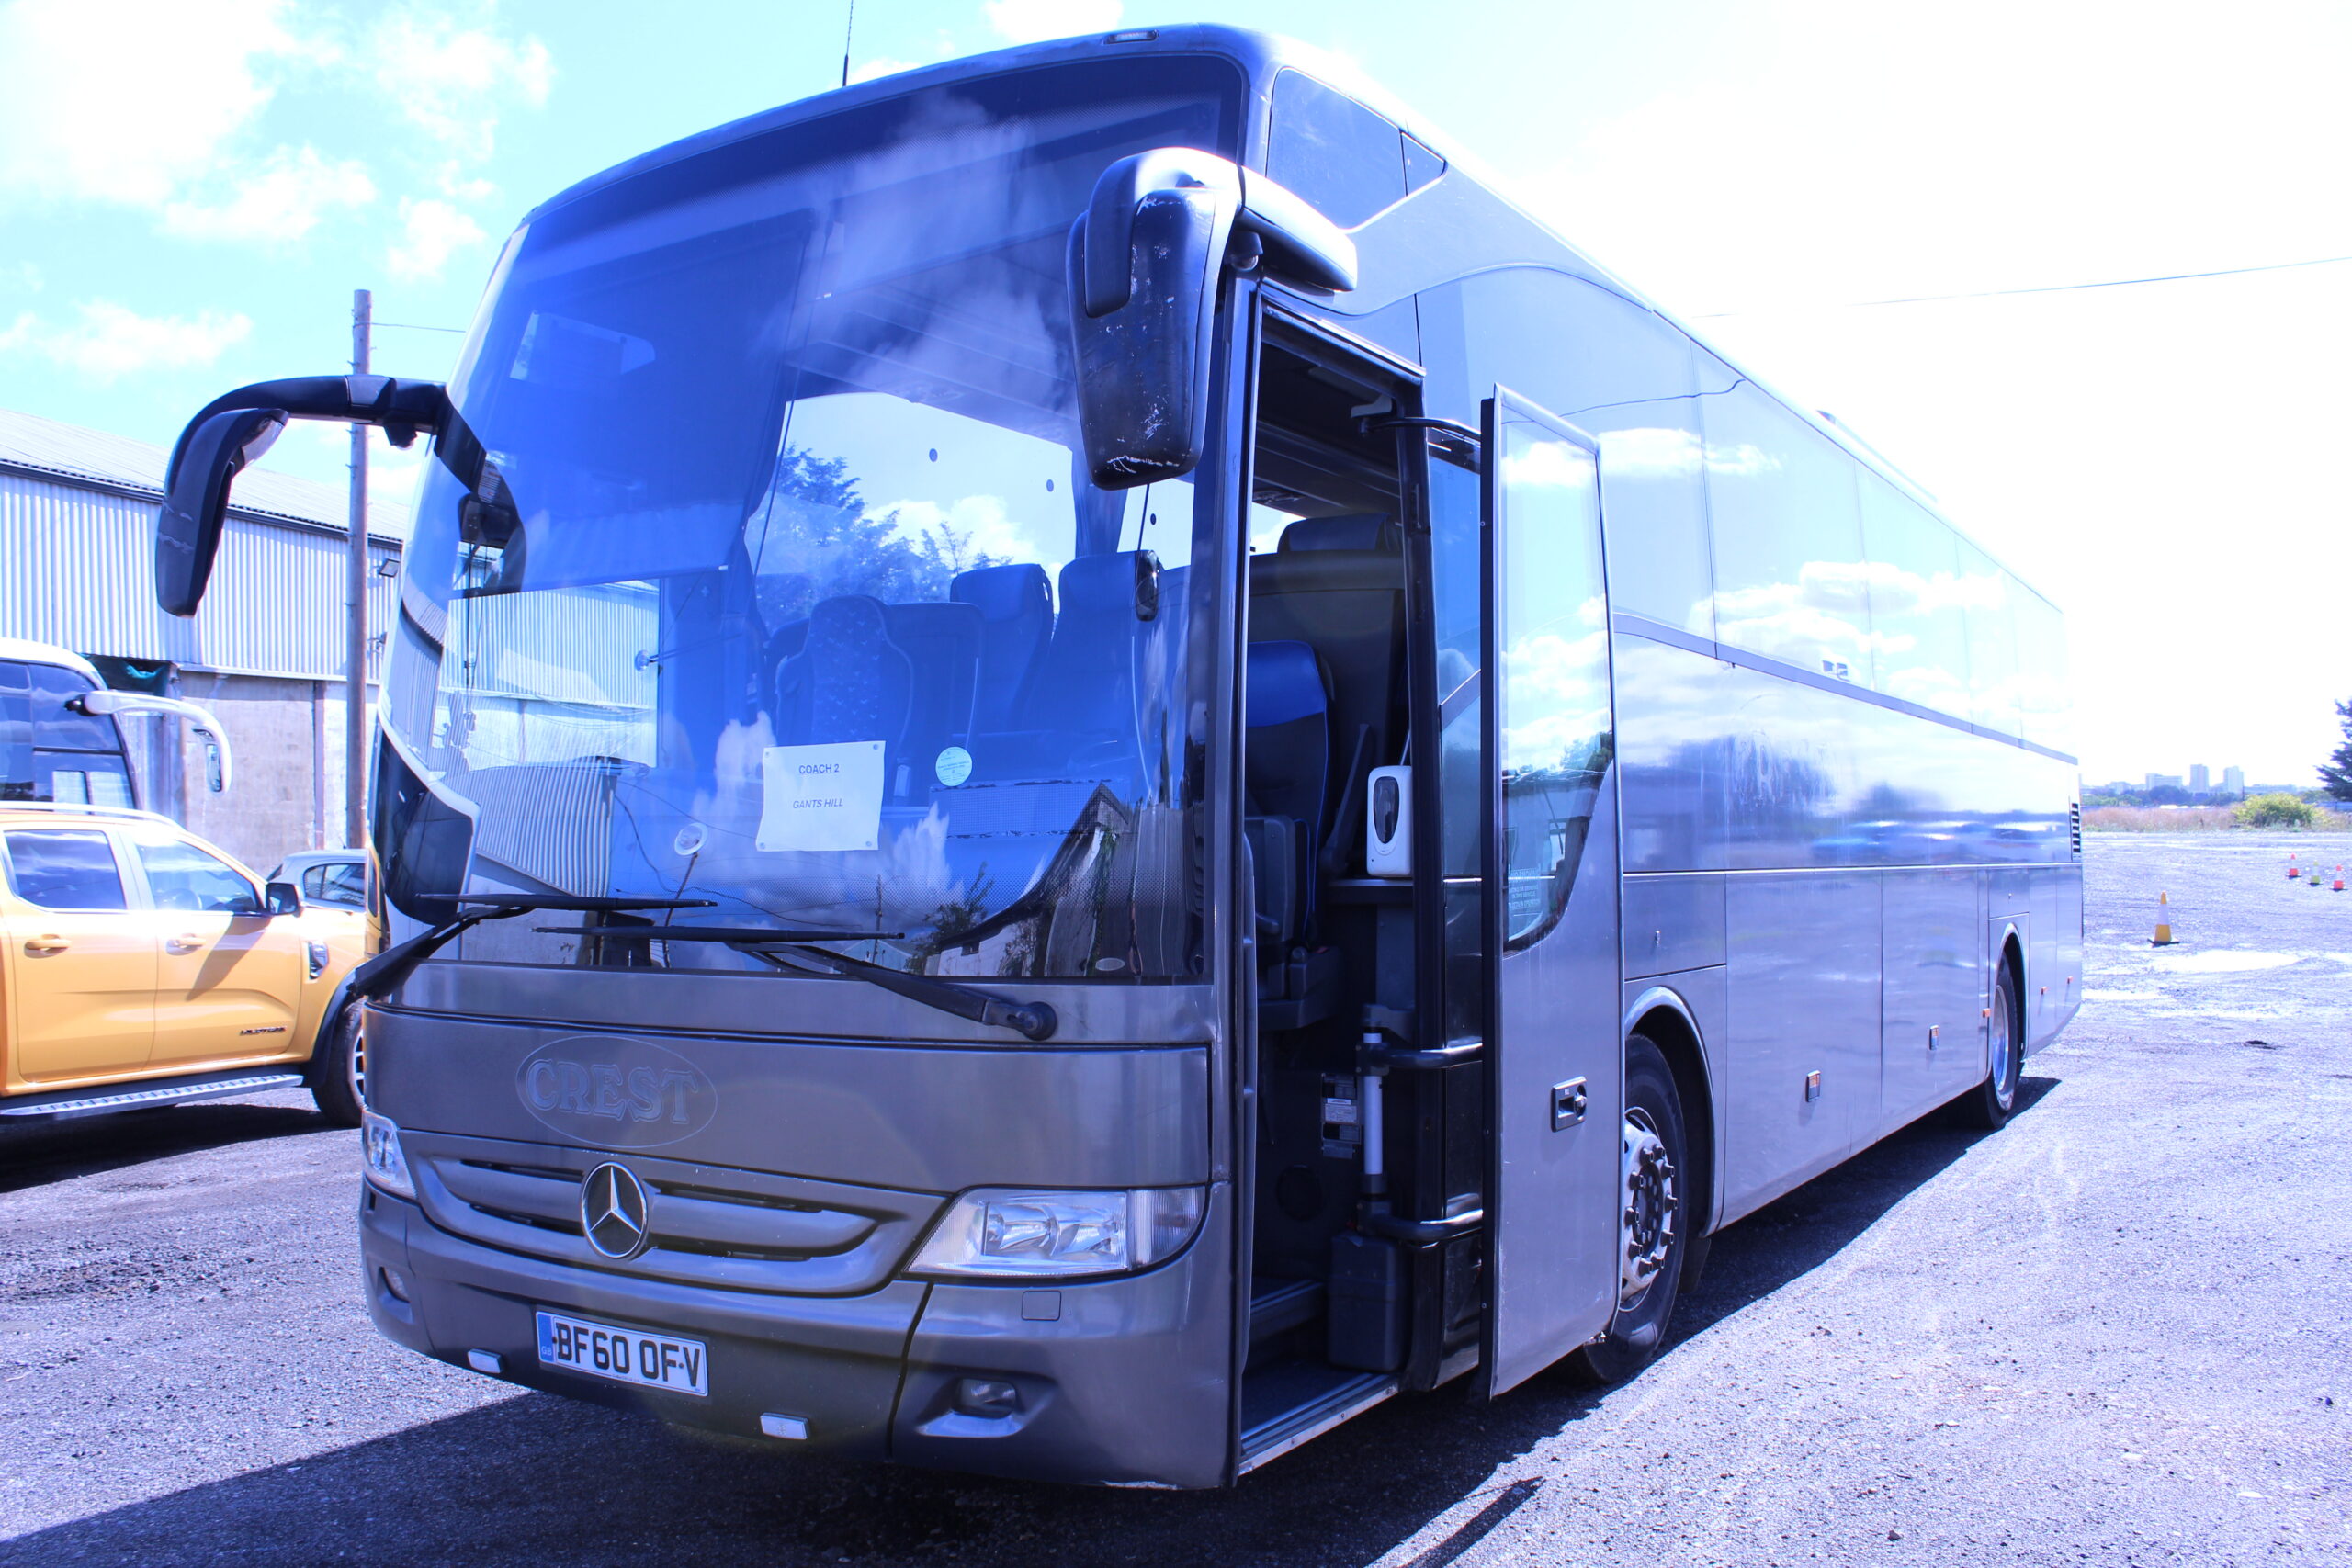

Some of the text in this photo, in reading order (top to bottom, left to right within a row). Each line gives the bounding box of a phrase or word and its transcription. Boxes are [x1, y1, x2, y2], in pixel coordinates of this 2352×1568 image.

[798, 763, 840, 774] COACH 2
[792, 798, 844, 809] GANTS HILL
[526, 1059, 698, 1123] CREST
[541, 1347, 553, 1356] GB
[558, 1323, 701, 1387] BF60 OFV
